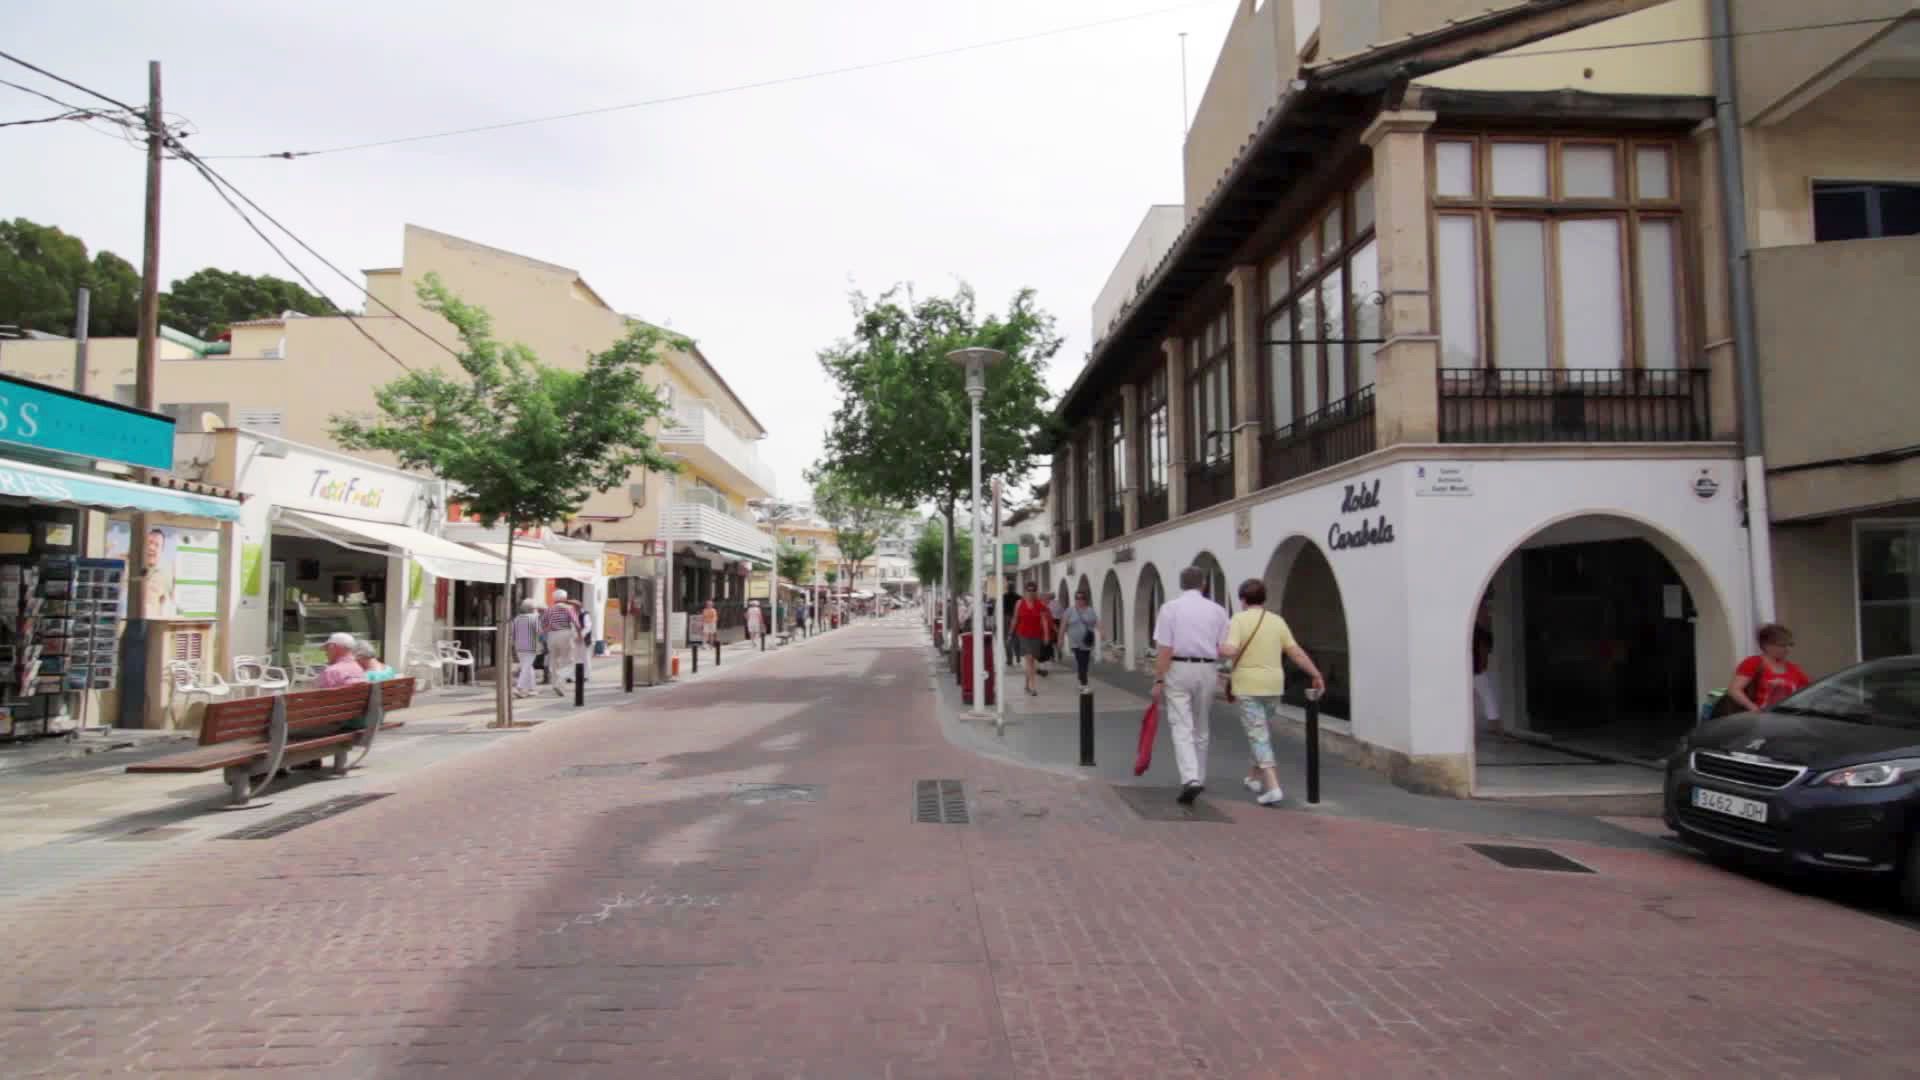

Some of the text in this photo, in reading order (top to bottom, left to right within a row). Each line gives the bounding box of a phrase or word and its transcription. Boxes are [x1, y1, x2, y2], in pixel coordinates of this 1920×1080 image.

[1340, 478, 1380, 513] Hotel
[1328, 515, 1395, 550] Carabela
[1701, 791, 1733, 812] 3462
